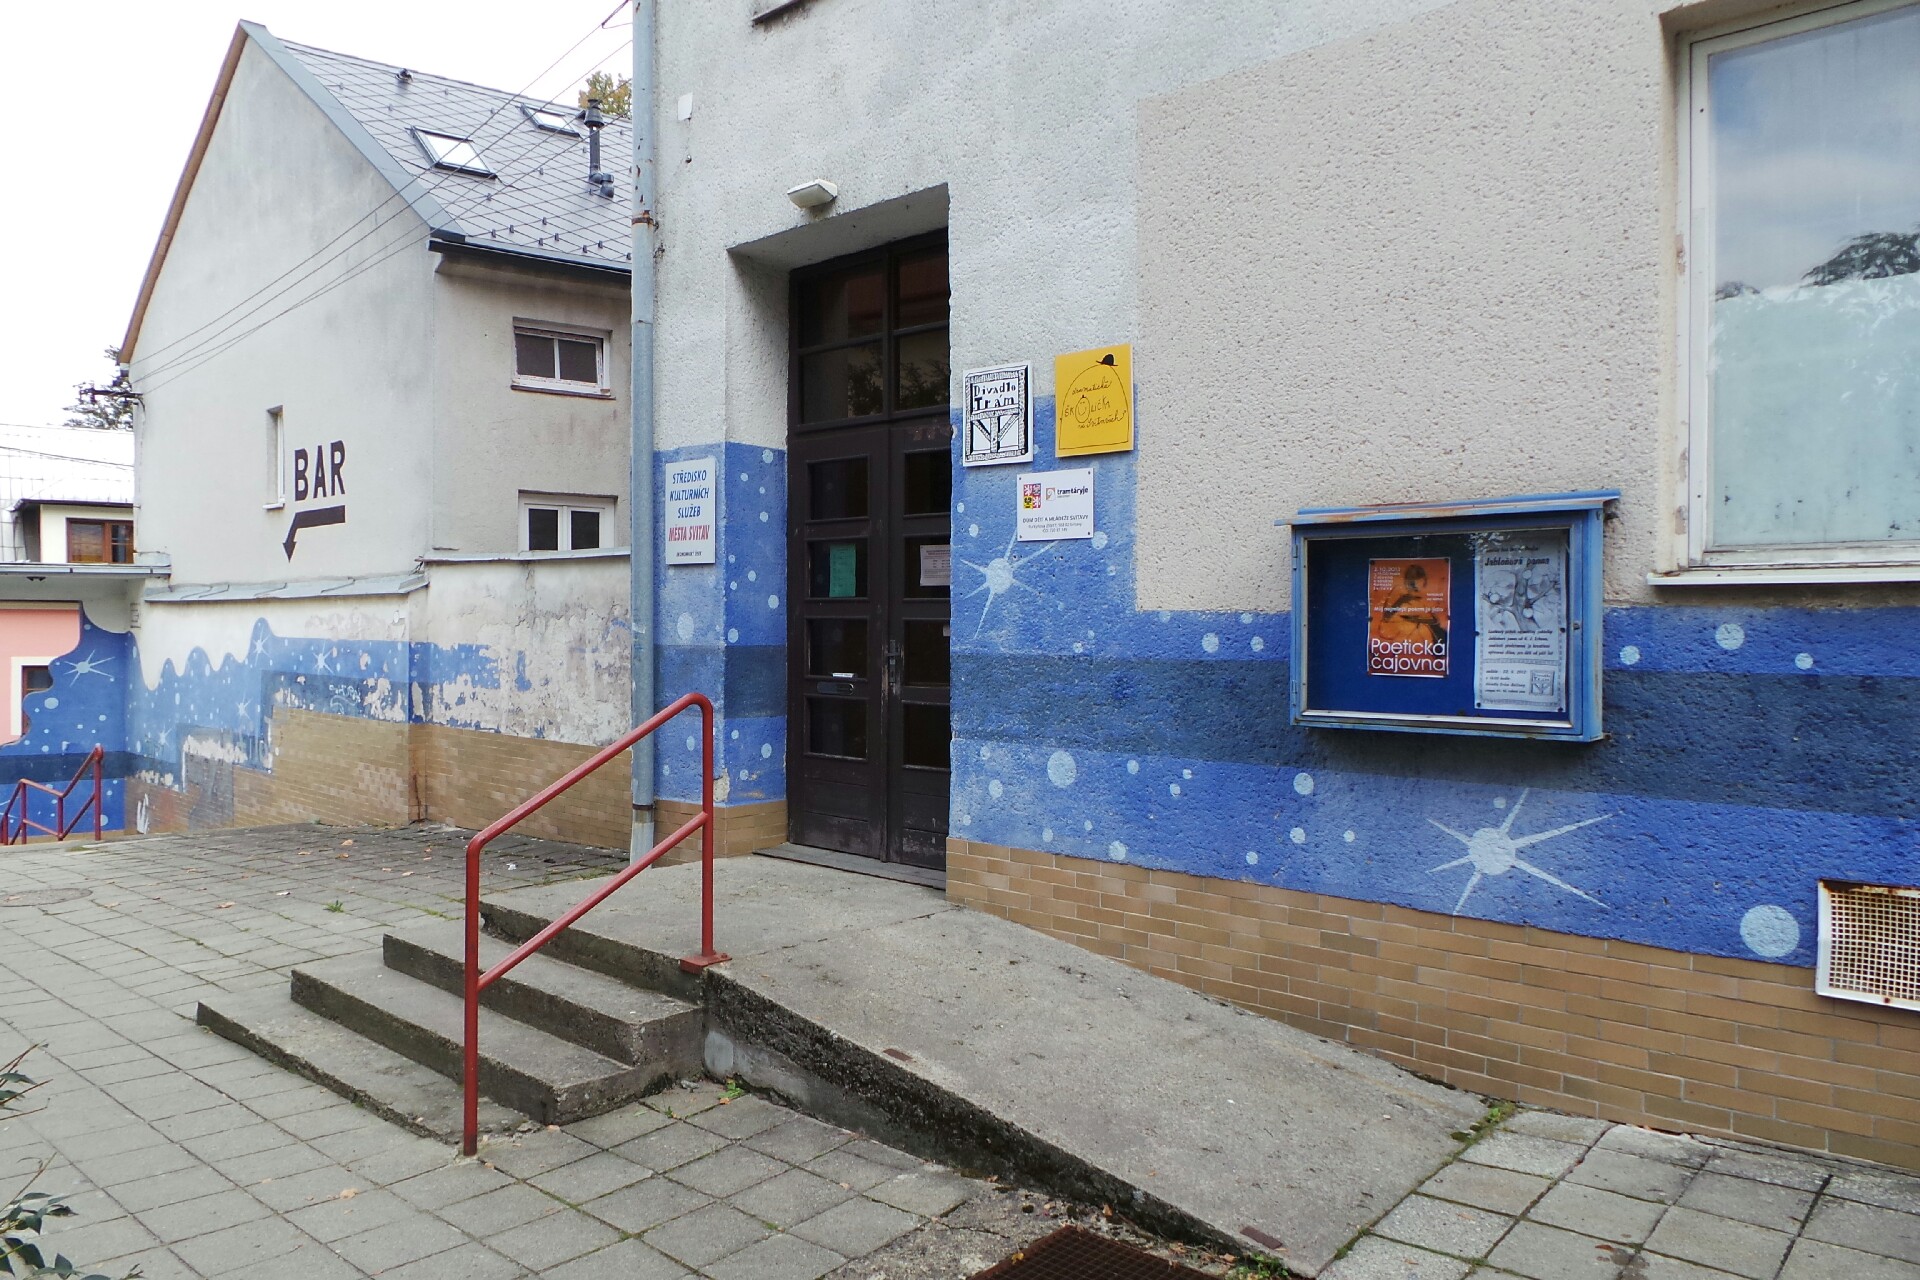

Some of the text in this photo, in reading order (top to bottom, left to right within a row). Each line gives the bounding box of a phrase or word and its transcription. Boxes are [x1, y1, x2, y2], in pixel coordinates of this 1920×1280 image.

[974, 382, 1016, 397] Divadlo
[974, 394, 1015, 410] Trám
[294, 440, 346, 502] BAR
[672, 469, 707, 485] STŘEDISKO
[669, 485, 710, 502] KULTURNÍCH
[1057, 486, 1089, 495] tramtáryje
[677, 503, 701, 519] SLUŽEB
[669, 523, 710, 541] MĚSTA SVITAV
[1371, 638, 1445, 656] Poetická
[1371, 653, 1446, 673] čajovna
